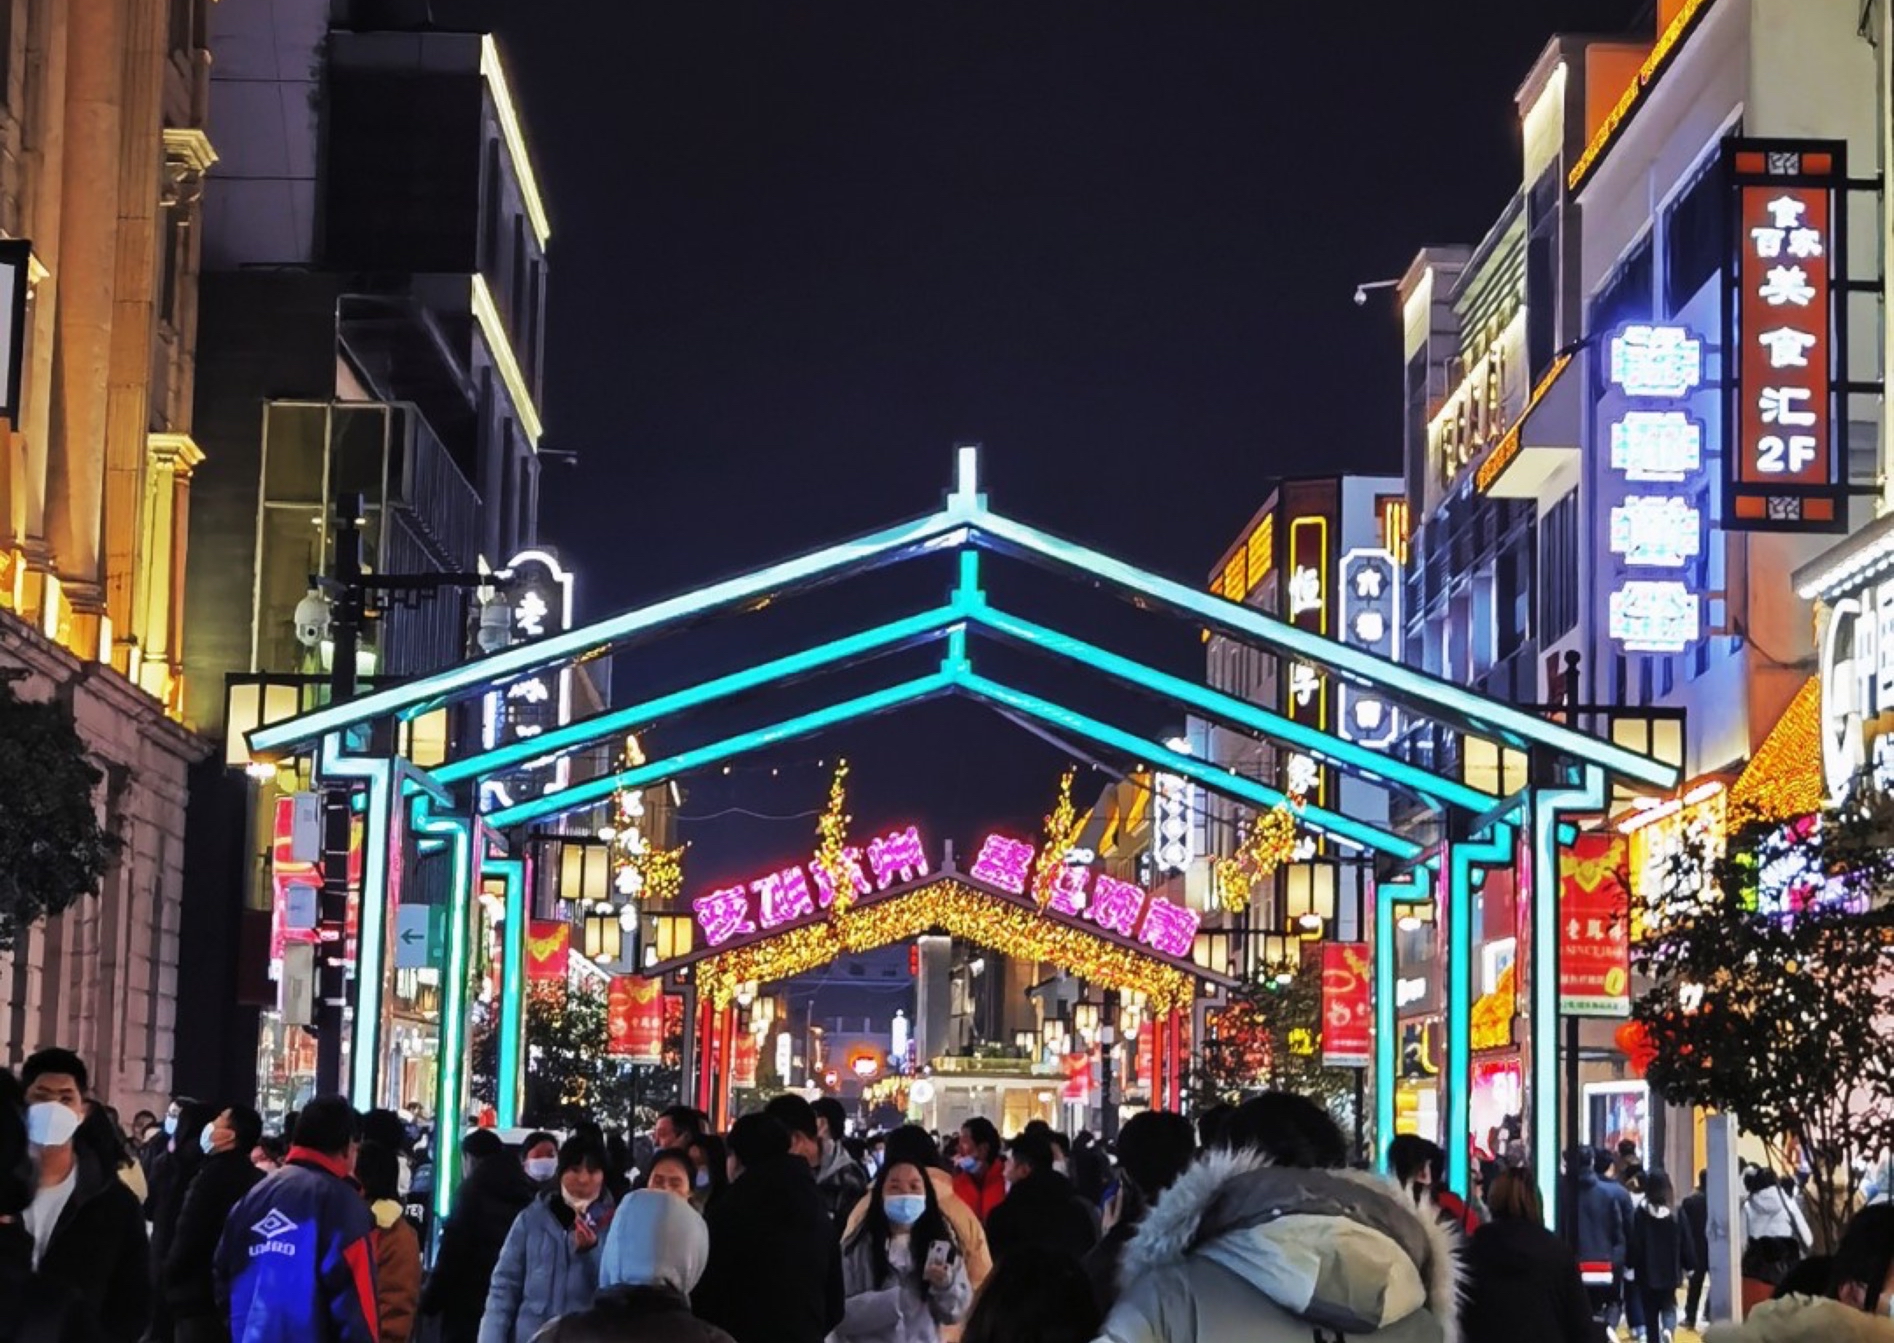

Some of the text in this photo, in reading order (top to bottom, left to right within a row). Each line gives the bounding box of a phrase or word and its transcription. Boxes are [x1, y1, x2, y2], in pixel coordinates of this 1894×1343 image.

[1758, 264, 1816, 427] 美食汇
[1756, 435, 1817, 473] 2F
